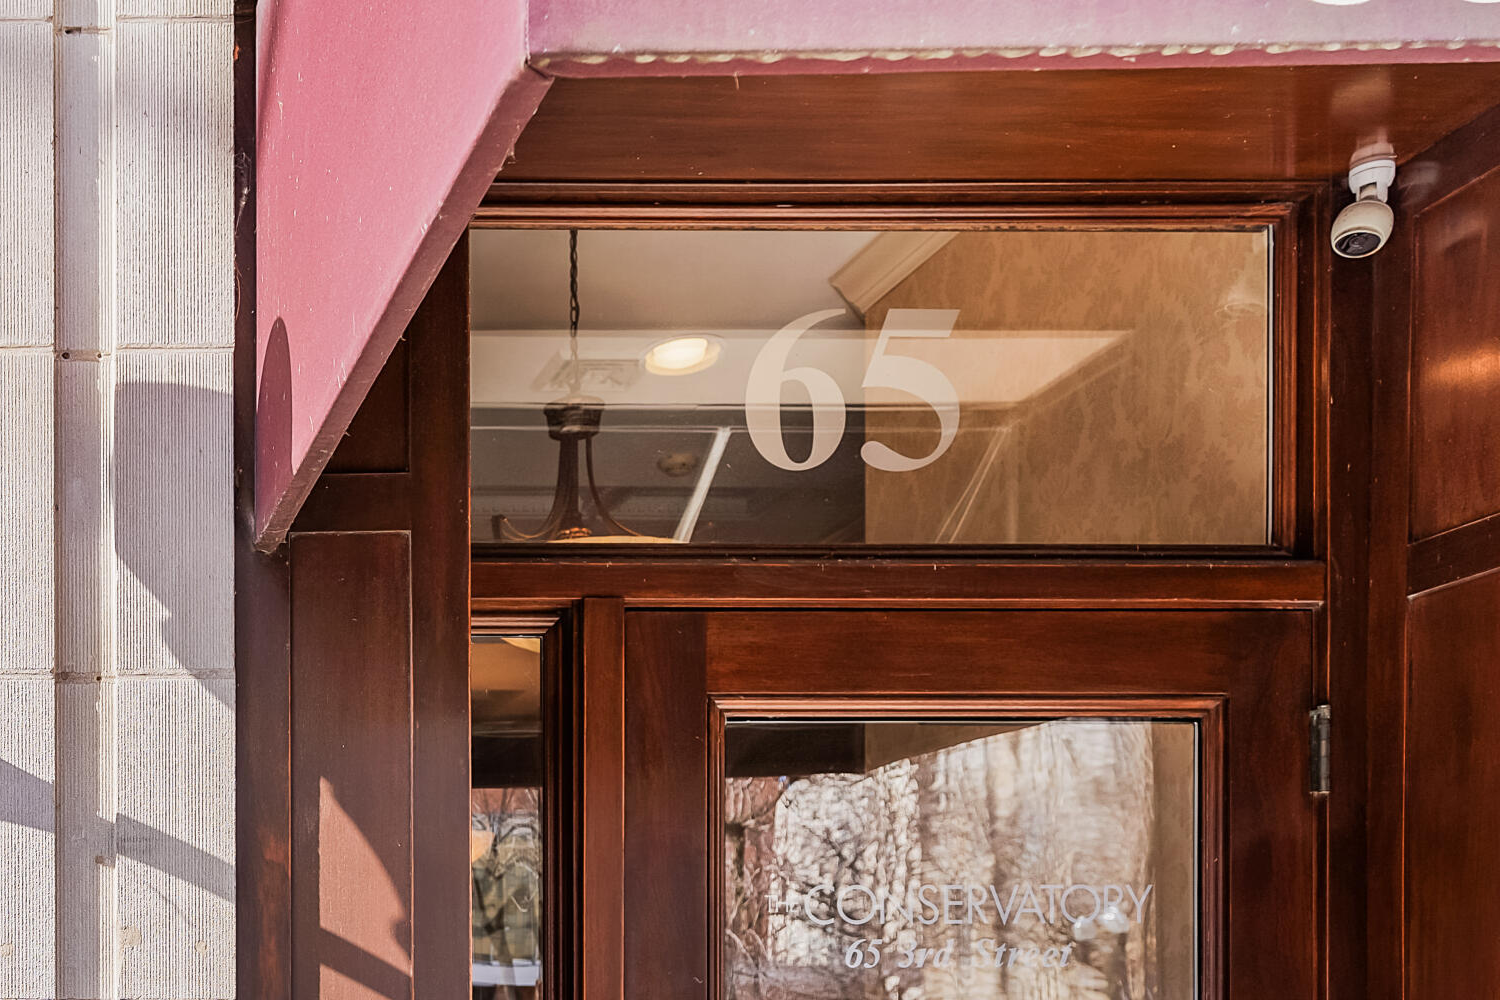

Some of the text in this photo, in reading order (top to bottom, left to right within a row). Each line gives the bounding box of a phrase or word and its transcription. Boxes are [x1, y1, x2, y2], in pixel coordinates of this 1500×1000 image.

[744, 307, 961, 472] 65
[764, 884, 1153, 926] THE CONSERVATORY
[845, 937, 1074, 969] 65 3rd Street
